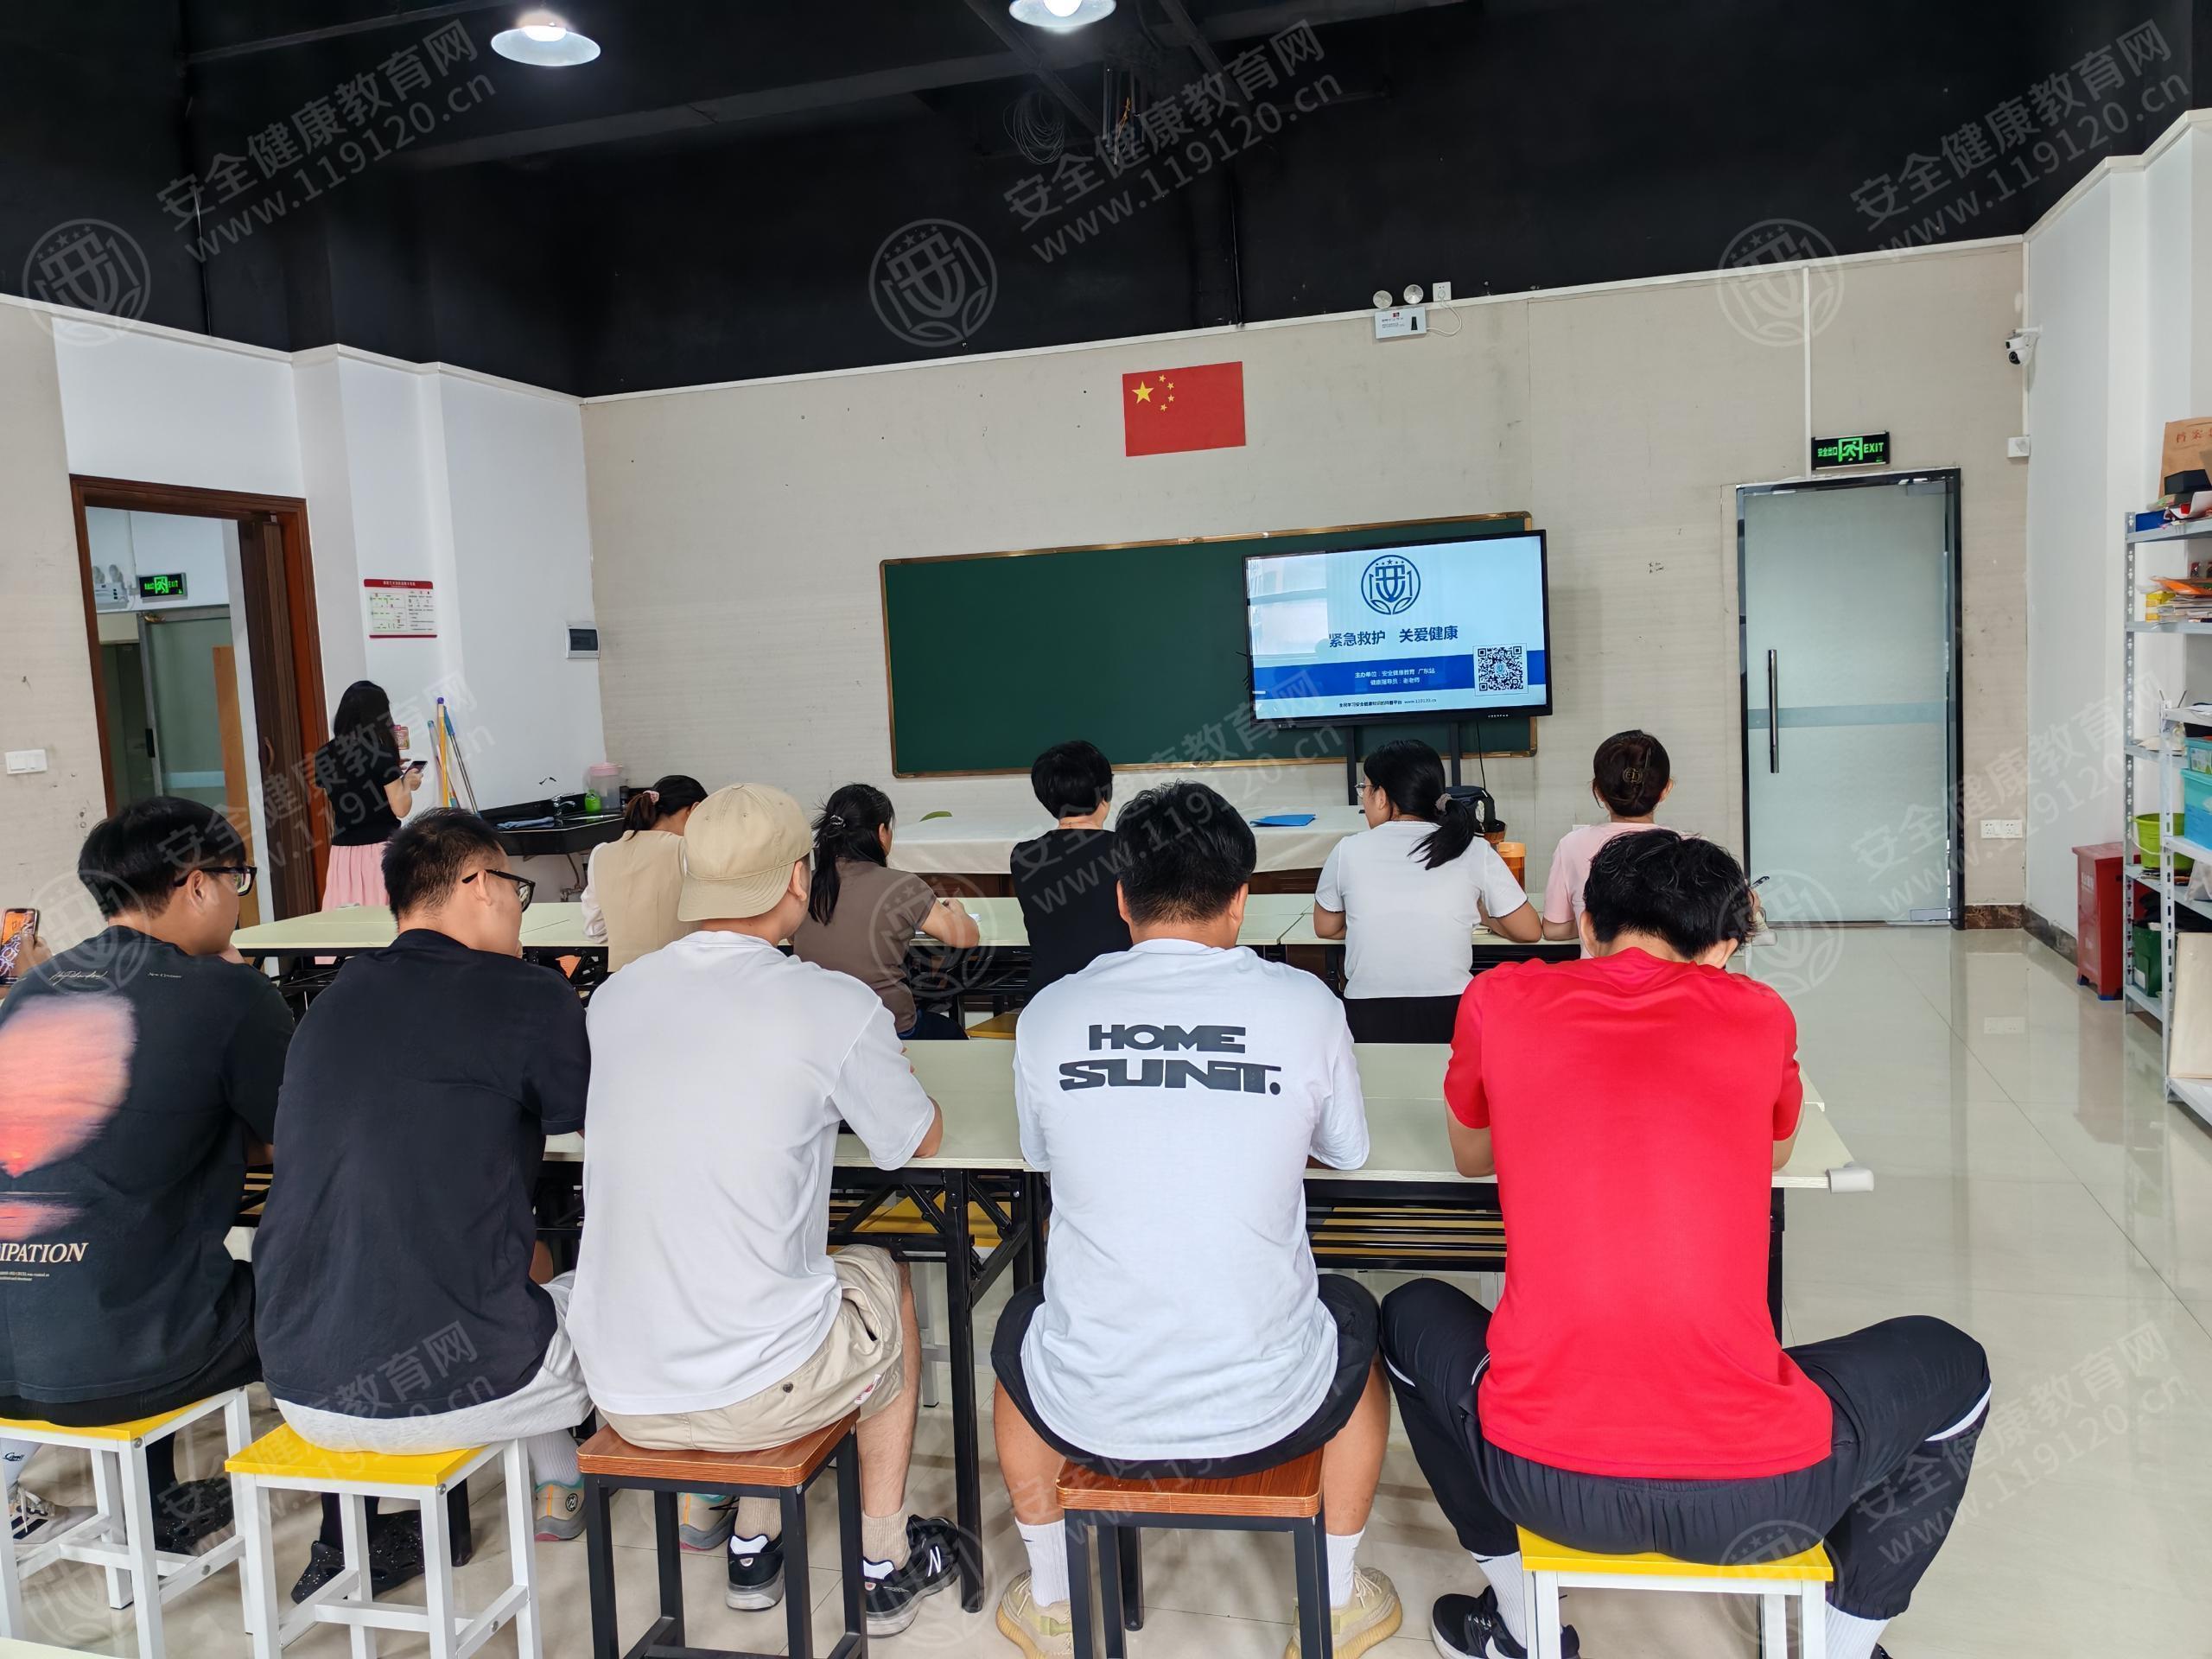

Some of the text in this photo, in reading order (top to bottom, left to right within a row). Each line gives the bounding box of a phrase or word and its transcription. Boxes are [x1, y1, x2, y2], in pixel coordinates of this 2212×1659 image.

[1864, 442, 1884, 453] EXIT
[1329, 625, 1459, 648] 紧急救护 关爱健康
[1089, 1024, 1245, 1053] HOME
